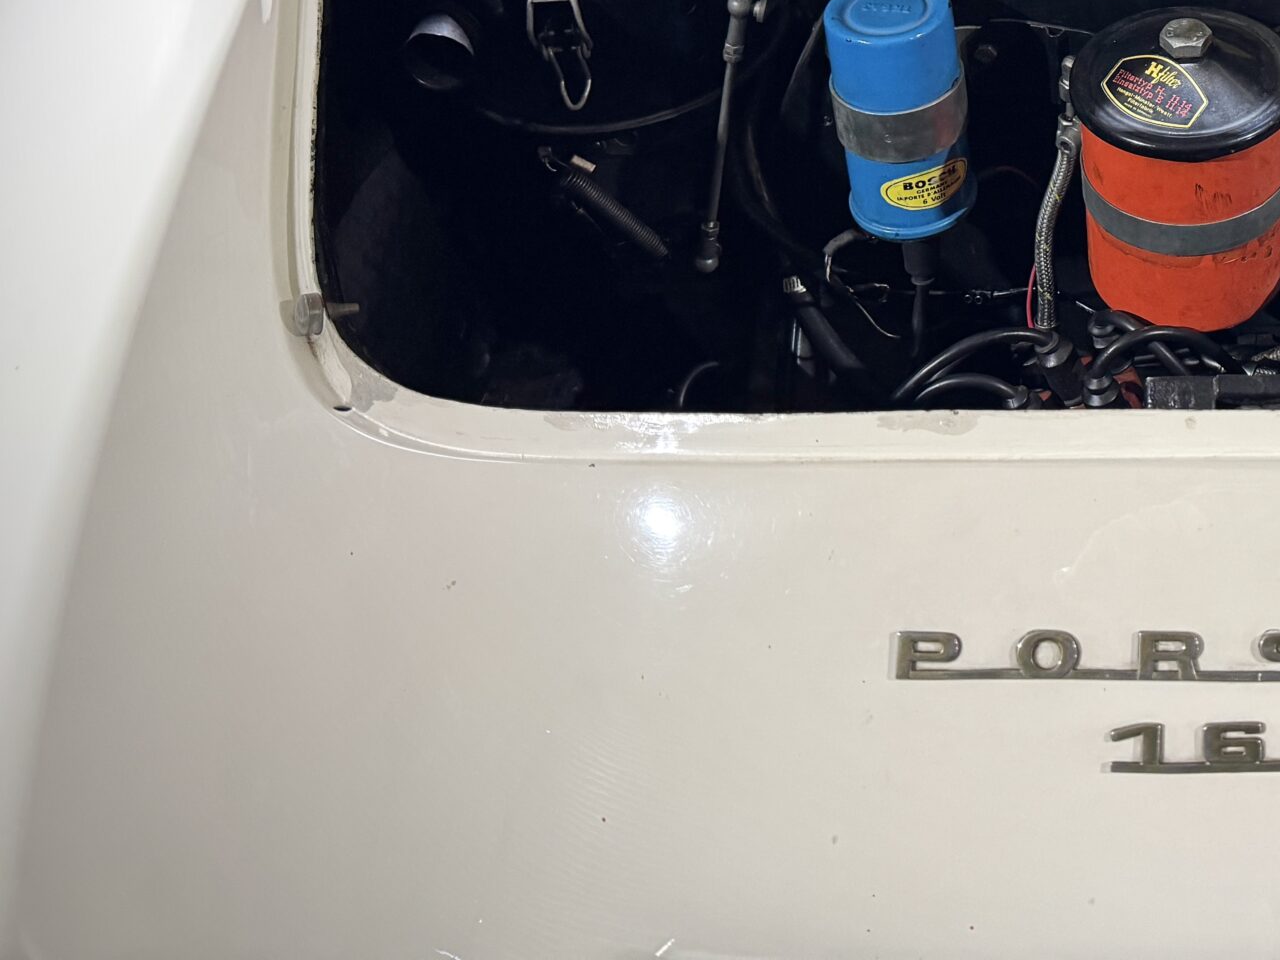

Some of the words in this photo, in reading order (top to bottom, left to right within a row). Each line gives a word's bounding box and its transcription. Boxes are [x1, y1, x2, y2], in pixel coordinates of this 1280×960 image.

[1116, 69, 1154, 90] Filtertyp
[903, 165, 956, 191] BOSCH
[931, 192, 946, 202] Volt
